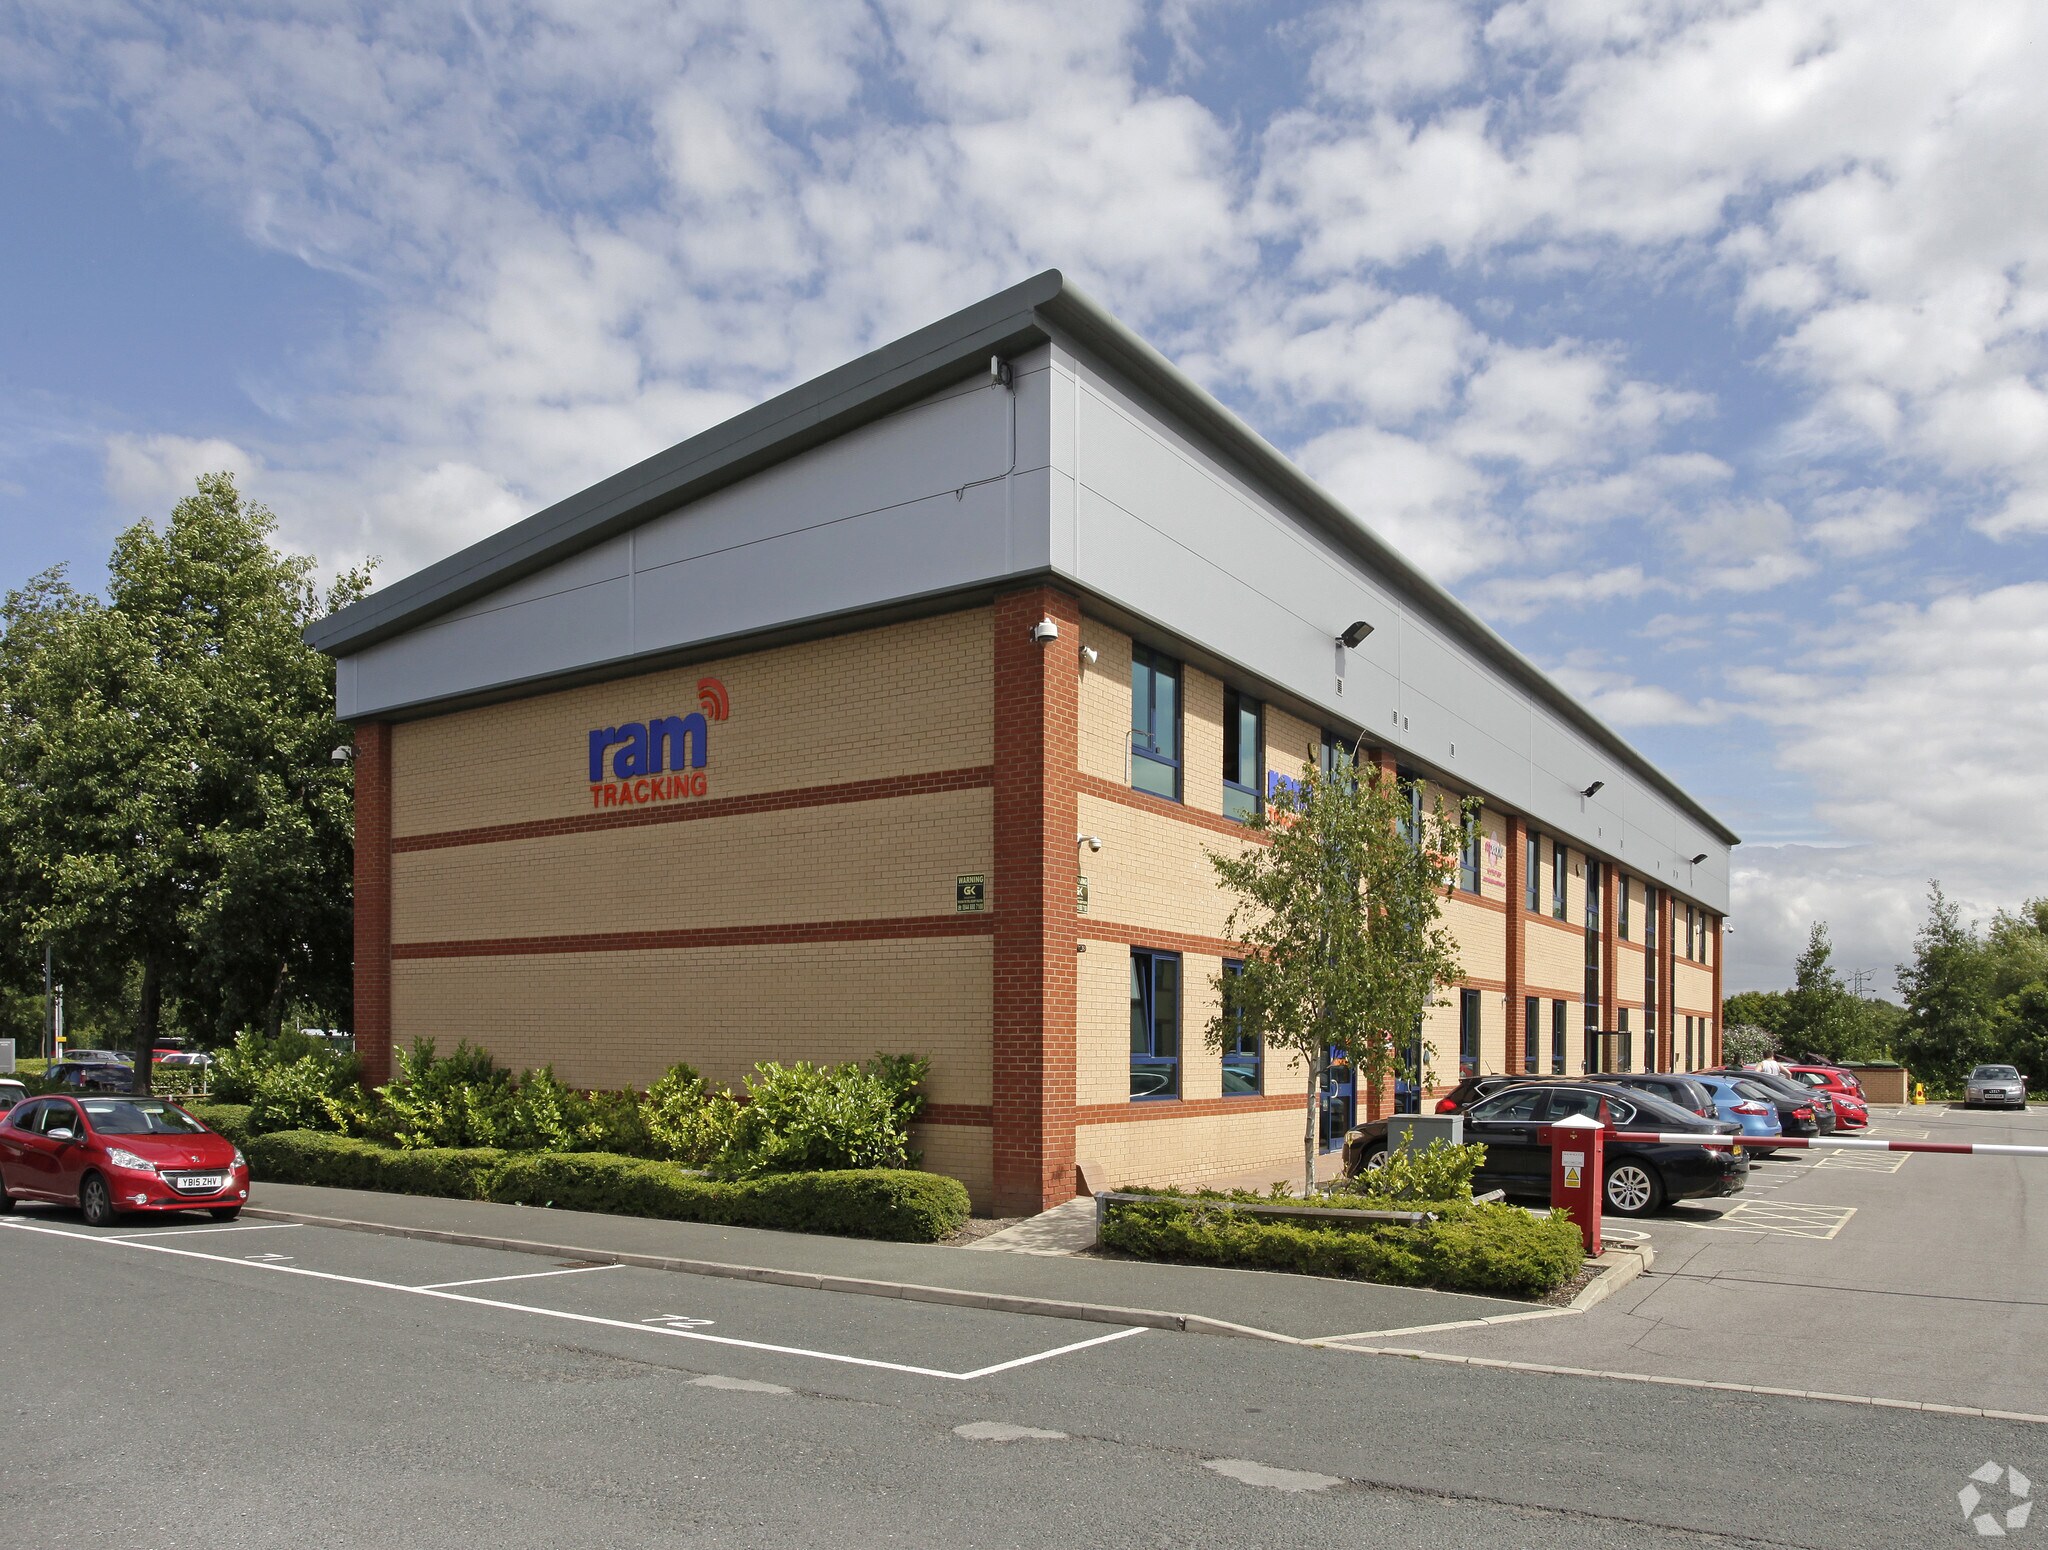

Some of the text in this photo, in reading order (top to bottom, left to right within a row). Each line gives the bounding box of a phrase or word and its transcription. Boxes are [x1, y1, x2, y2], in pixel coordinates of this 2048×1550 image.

[589, 712, 707, 782] ram
[590, 771, 707, 808] TRACKING
[958, 876, 984, 884] WARNING
[183, 1177, 217, 1186] YB15 ZHV
